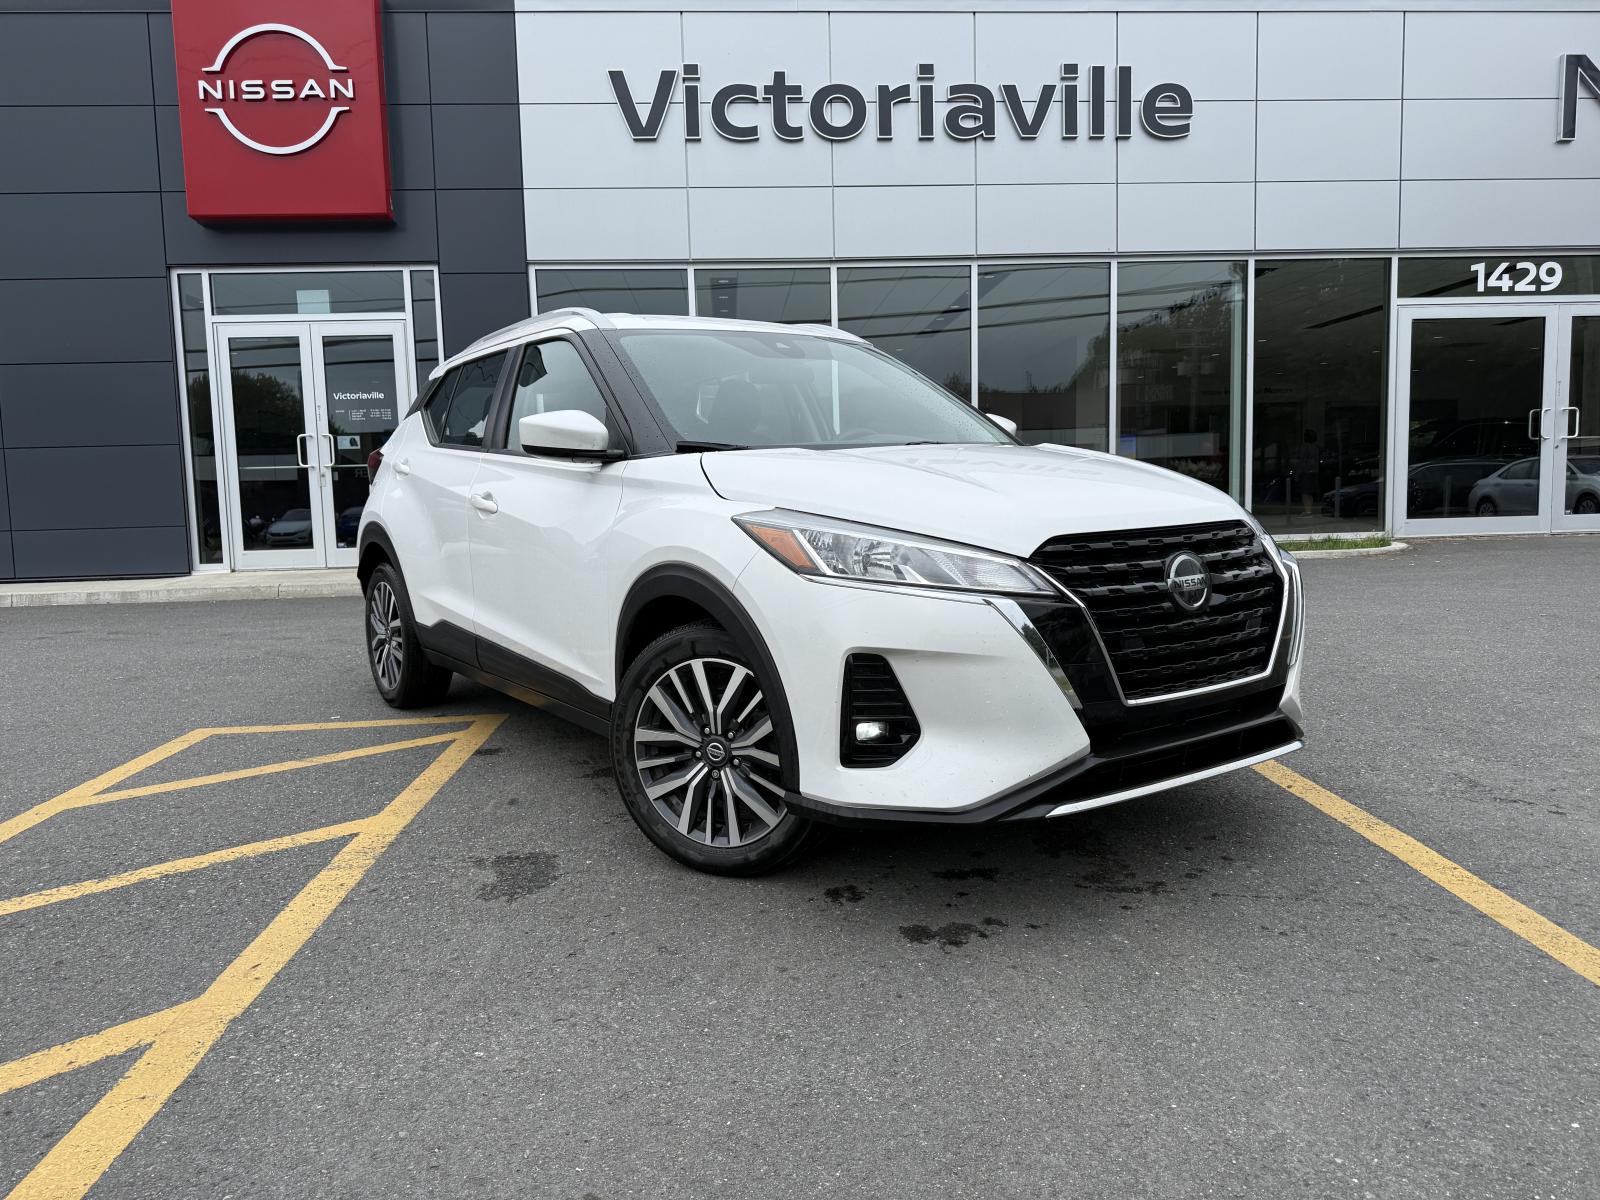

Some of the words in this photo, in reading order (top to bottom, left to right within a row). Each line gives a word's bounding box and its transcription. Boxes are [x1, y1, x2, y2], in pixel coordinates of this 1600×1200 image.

[198, 78, 355, 100] NISSAN
[607, 63, 1195, 141] Victoriaville
[1470, 261, 1563, 292] 1429
[333, 392, 384, 400] Victoriaville
[1174, 577, 1207, 589] NISSAN
